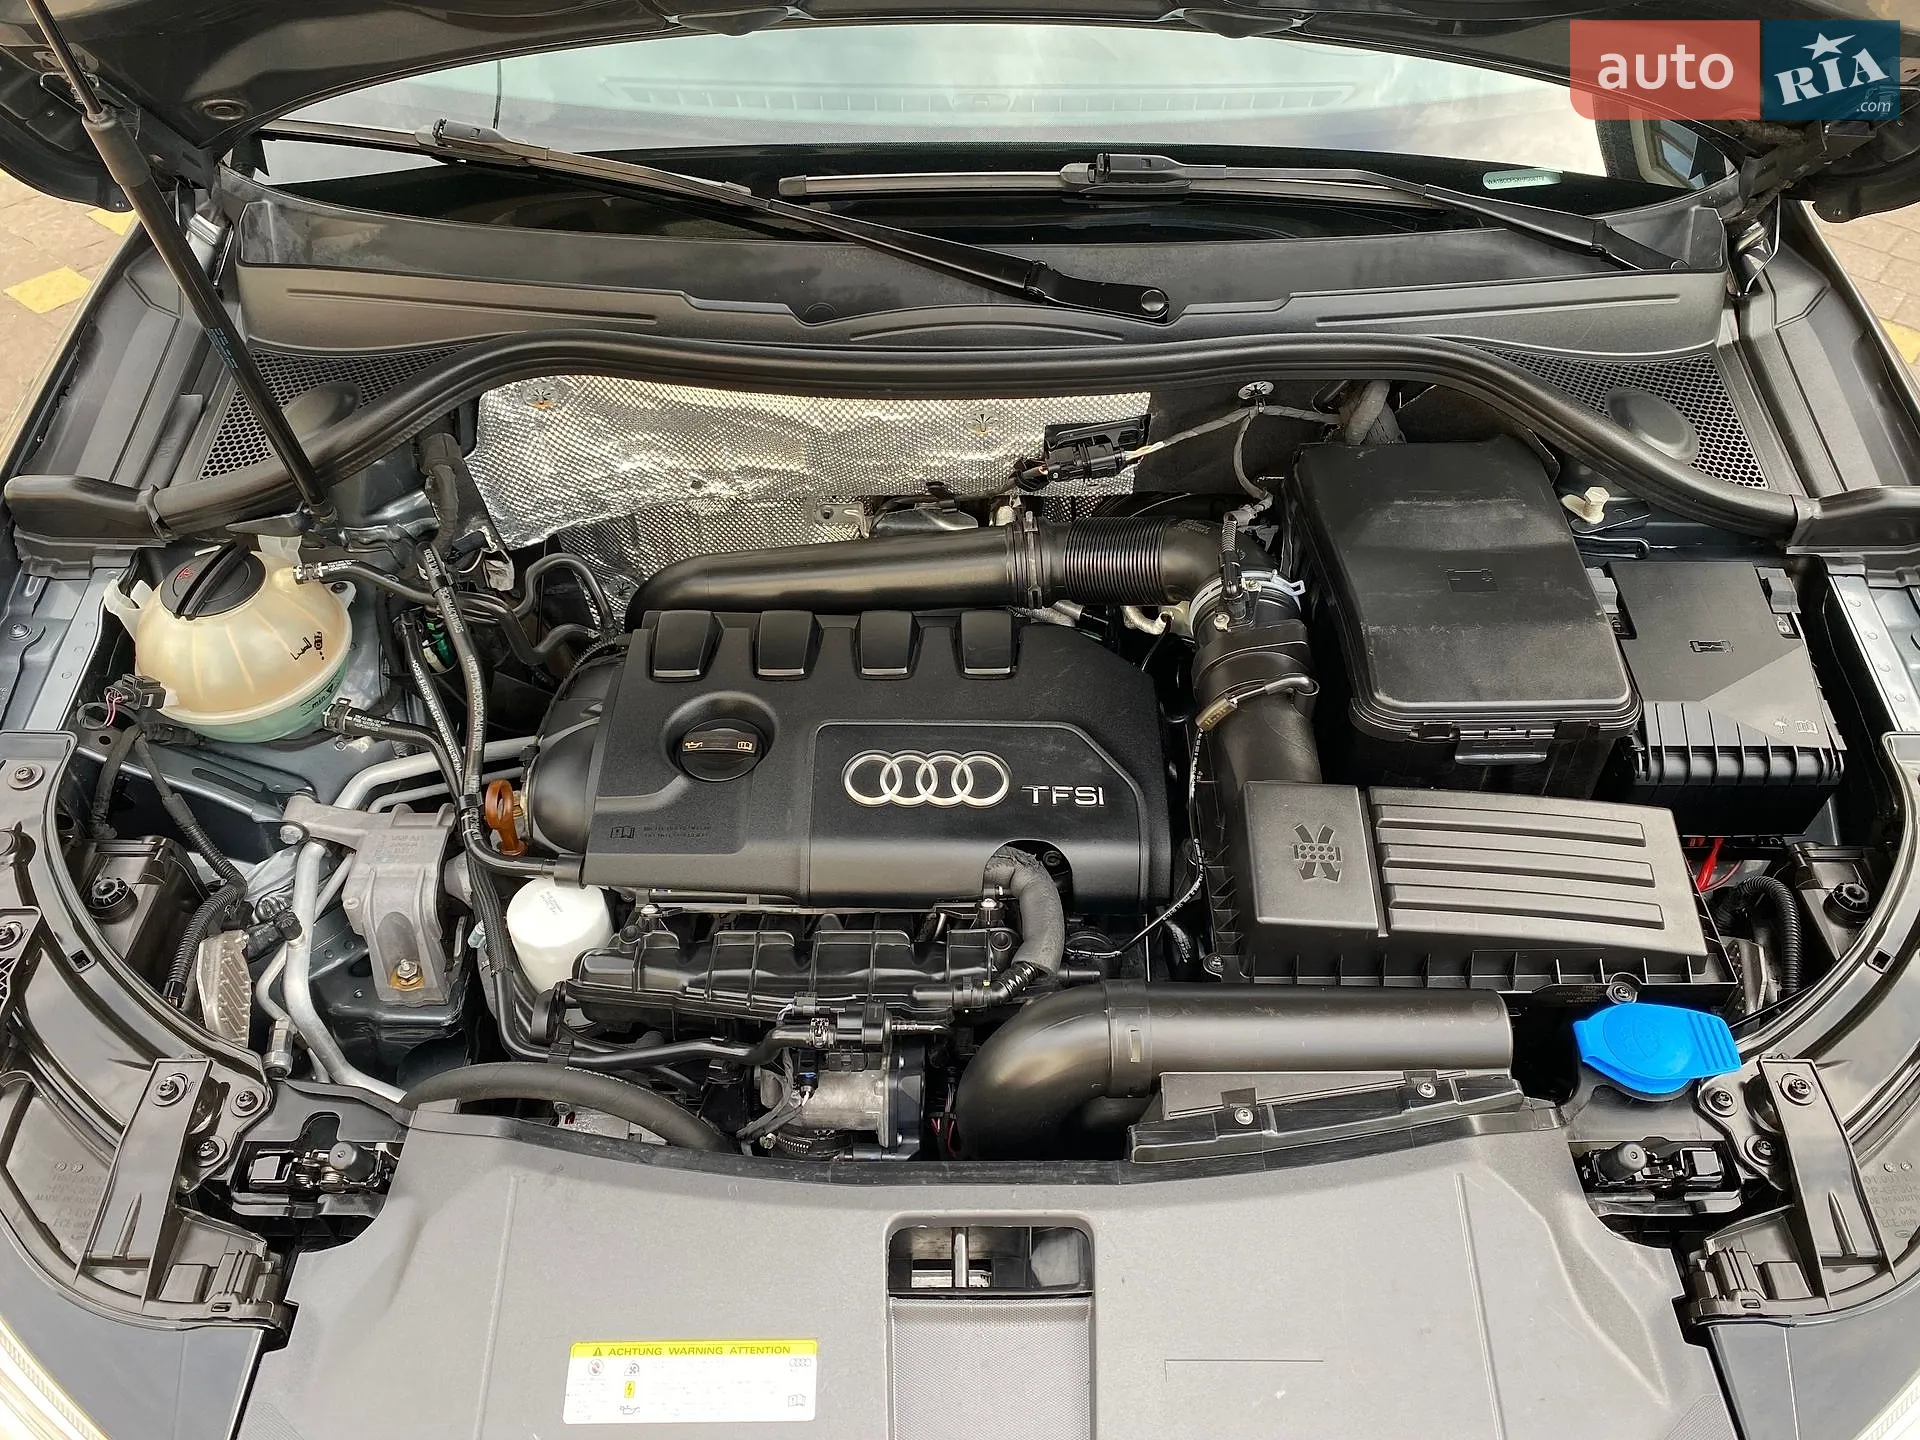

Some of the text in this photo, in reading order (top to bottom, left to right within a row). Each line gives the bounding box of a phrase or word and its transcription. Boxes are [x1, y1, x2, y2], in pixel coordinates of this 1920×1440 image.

[311, 696, 326, 709] min
[1021, 786, 1105, 807] TFSI
[608, 1346, 791, 1356] ACHTUNG WARNING ATTENTION
